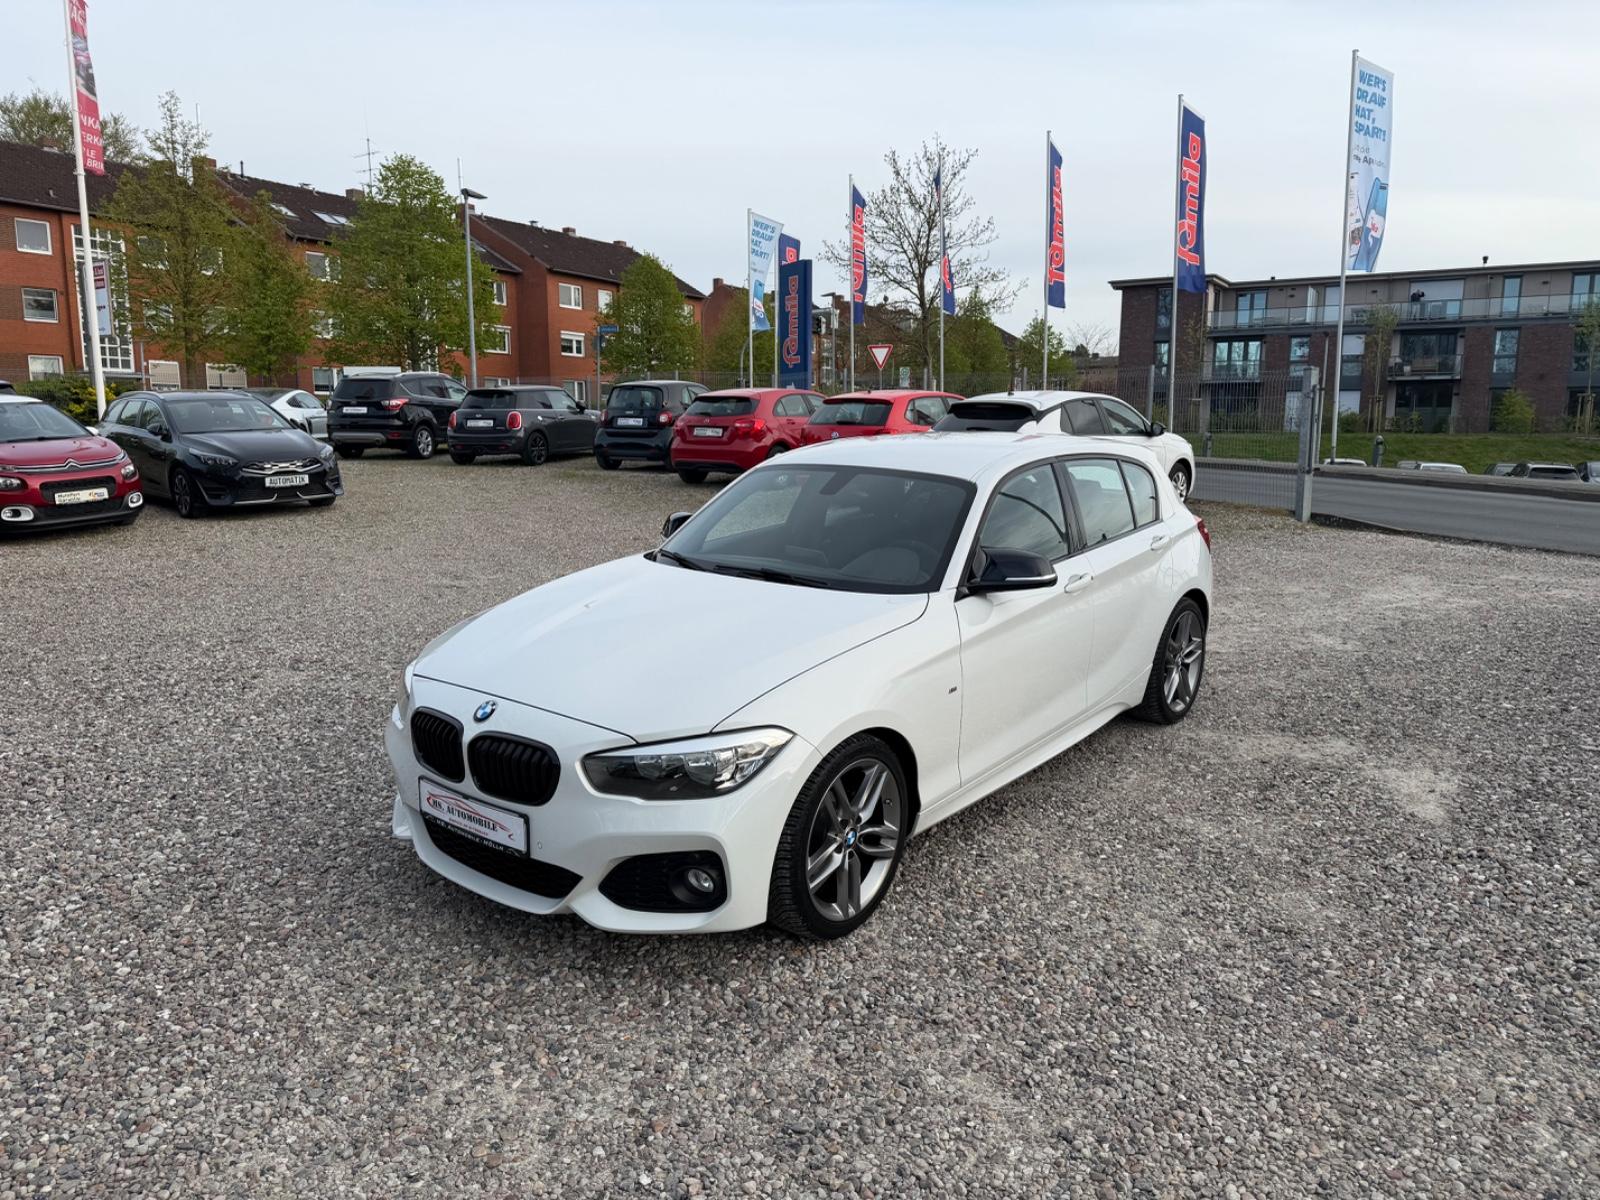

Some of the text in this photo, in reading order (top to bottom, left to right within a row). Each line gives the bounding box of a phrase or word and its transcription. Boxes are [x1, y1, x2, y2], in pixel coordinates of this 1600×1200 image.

[1359, 69, 1387, 92] WER'S
[1356, 86, 1387, 109] DRAUF
[1177, 131, 1201, 267] famila
[753, 219, 777, 234] WER'S
[783, 274, 801, 369] famila
[268, 474, 307, 486] AUTOMATIK
[446, 805, 498, 832] AUTOMOBILE
